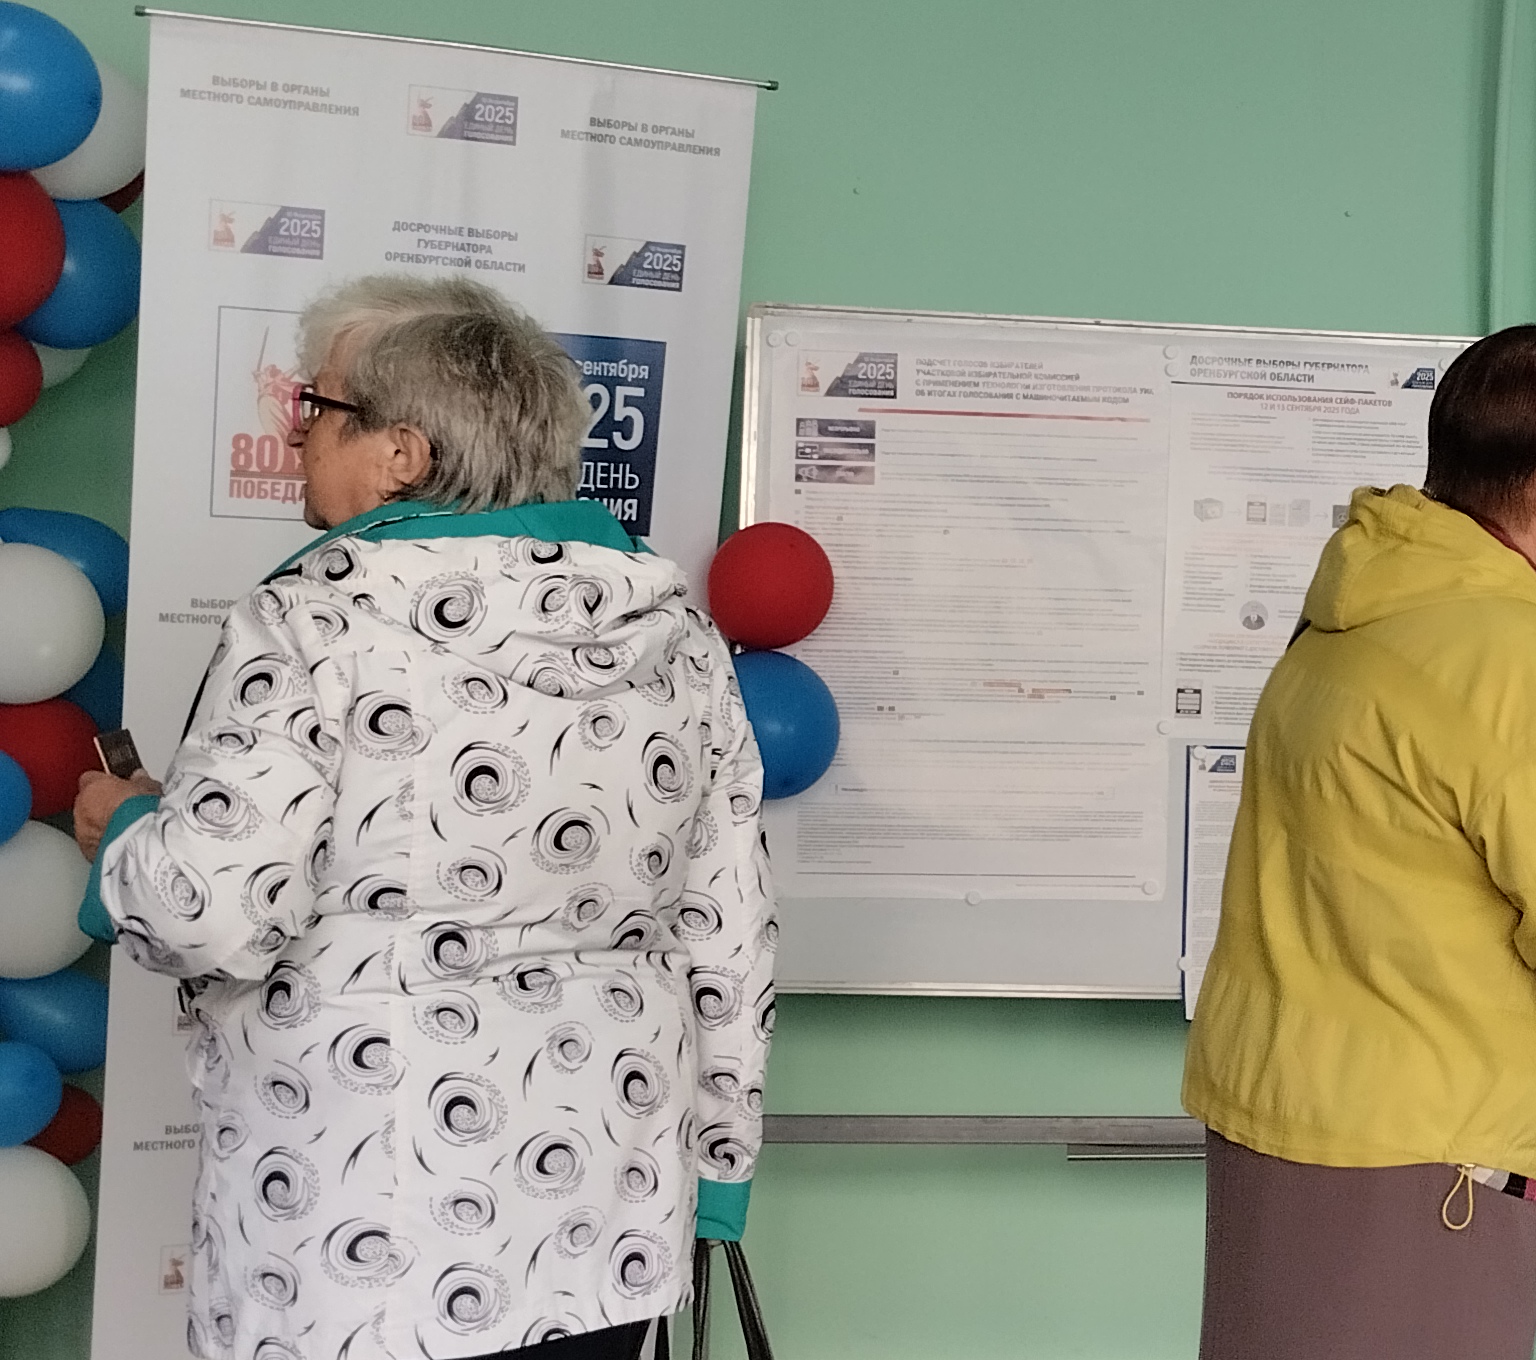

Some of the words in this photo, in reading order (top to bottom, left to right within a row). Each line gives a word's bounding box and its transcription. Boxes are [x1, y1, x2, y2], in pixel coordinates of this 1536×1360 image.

[212, 75, 267, 91] ВЫБОРЫ
[270, 82, 279, 92] В
[282, 83, 331, 97] ОРГАНЫ
[180, 88, 244, 104] МЕСТНОГО
[247, 95, 360, 116] САМОУПРАВЛЕНИЯ
[474, 103, 514, 125] 2025
[589, 116, 638, 132] ВЫБОРЫ
[641, 123, 648, 133] В
[651, 124, 695, 138] ОРГАНЫ
[560, 129, 616, 144] МЕСТНОГО
[619, 136, 721, 156] САМОУПРАВЛЕНИЯ
[279, 217, 321, 238] 2025
[392, 221, 465, 237] ДОСРОЧНЫЕ
[467, 227, 518, 241] ВЫБОРЫ
[417, 238, 493, 254] ГУБЕРНАТОРА
[384, 251, 472, 268] ОРЕНБУРГСКОЙ
[474, 259, 526, 273] ОБЛАСТИ
[642, 252, 682, 272] 2025
[857, 363, 895, 380] 2025
[1189, 355, 1254, 367] ДОСРОЧНЫЕ
[1255, 358, 1301, 370] ВЫБОРЫ
[1303, 361, 1370, 374] ГУБЕРНАТОРА
[1189, 367, 1267, 381] ОРЕНБУРГСКОЙ
[1269, 372, 1315, 383] ОБЛАСТИ
[1226, 392, 1265, 402] ПОРЯДОК
[1266, 393, 1333, 404] ИСПОЛЬЗОВАНИЯ
[230, 432, 279, 473] 80
[577, 461, 640, 492] ДЕНЬ
[190, 598, 237, 610] ВЫБОР
[158, 612, 222, 625] МЕСТНОГО
[133, 1139, 196, 1151] МЕСТНОГО
